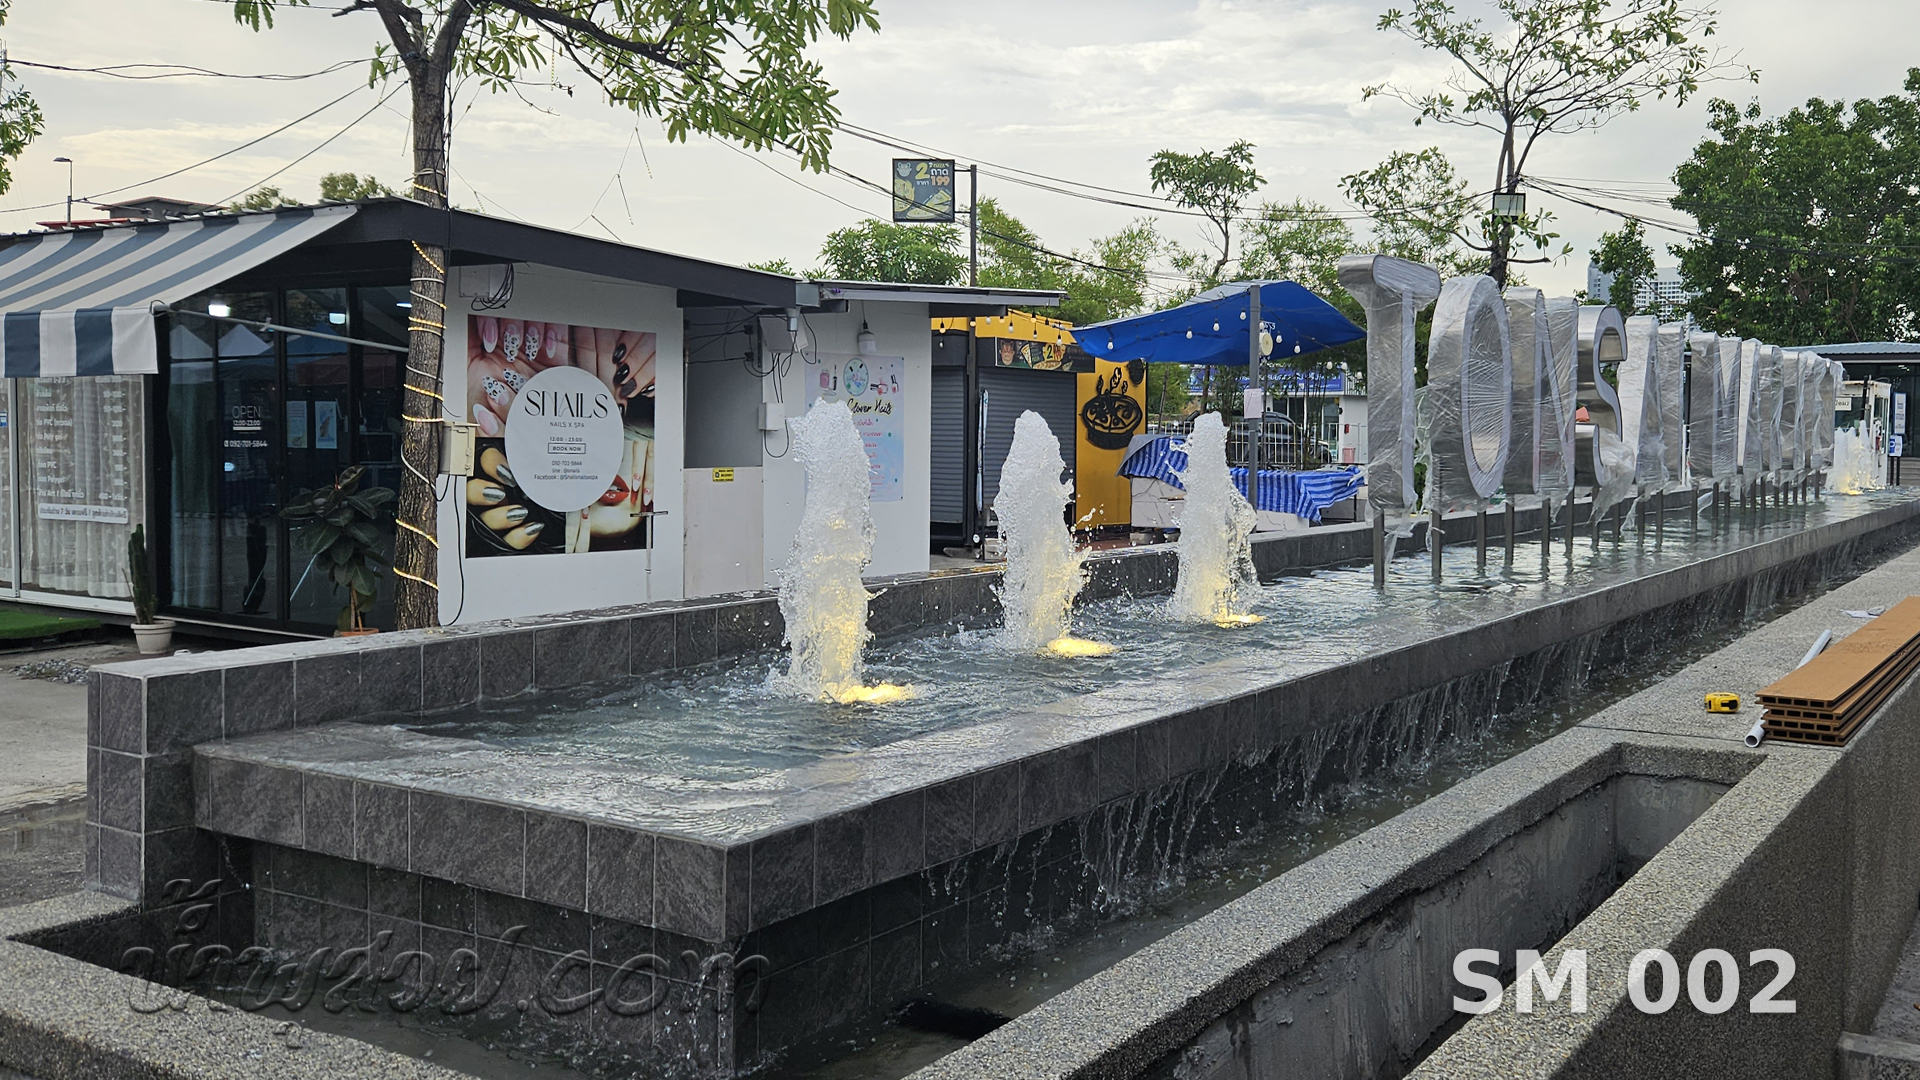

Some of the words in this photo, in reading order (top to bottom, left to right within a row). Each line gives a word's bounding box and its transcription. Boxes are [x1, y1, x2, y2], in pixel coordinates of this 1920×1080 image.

[915, 162, 930, 180] 2
[931, 175, 950, 186] 199
[231, 405, 261, 419] OPEN
[524, 389, 608, 419] SNAILS
